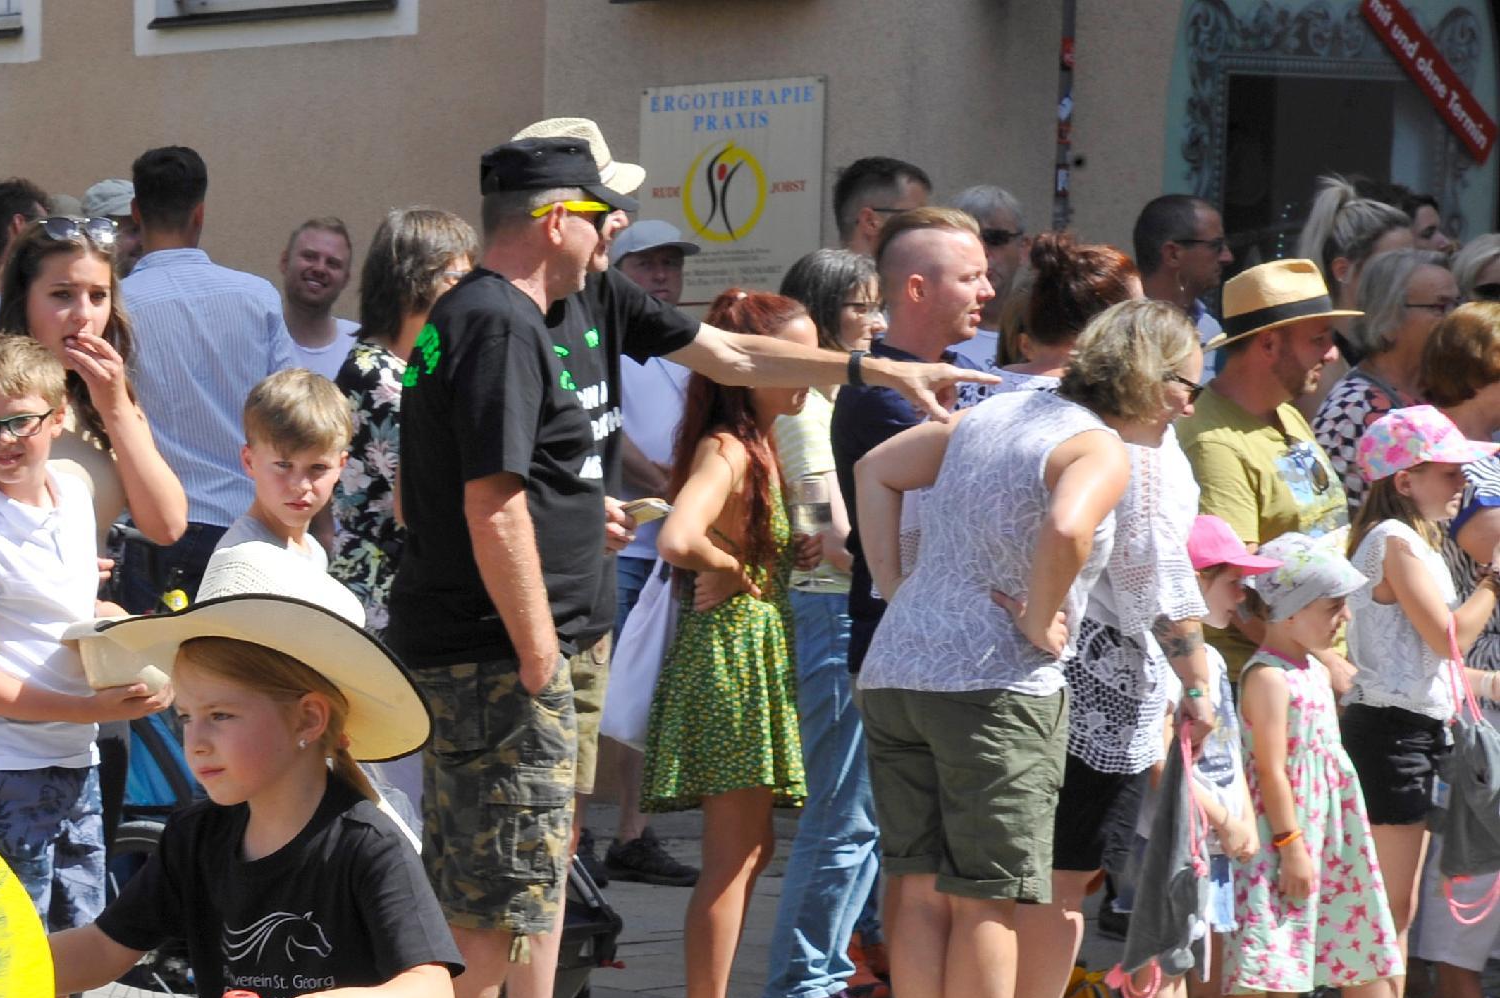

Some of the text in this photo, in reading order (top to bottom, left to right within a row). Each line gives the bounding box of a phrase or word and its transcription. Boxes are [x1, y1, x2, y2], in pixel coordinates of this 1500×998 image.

[650, 85, 815, 113] ERGOTHERAPIE
[1391, 24, 1420, 59] und
[1417, 57, 1447, 98] ohne
[1448, 90, 1488, 150] Termin
[693, 111, 769, 131] PRAXIS
[273, 974, 288, 990] St.
